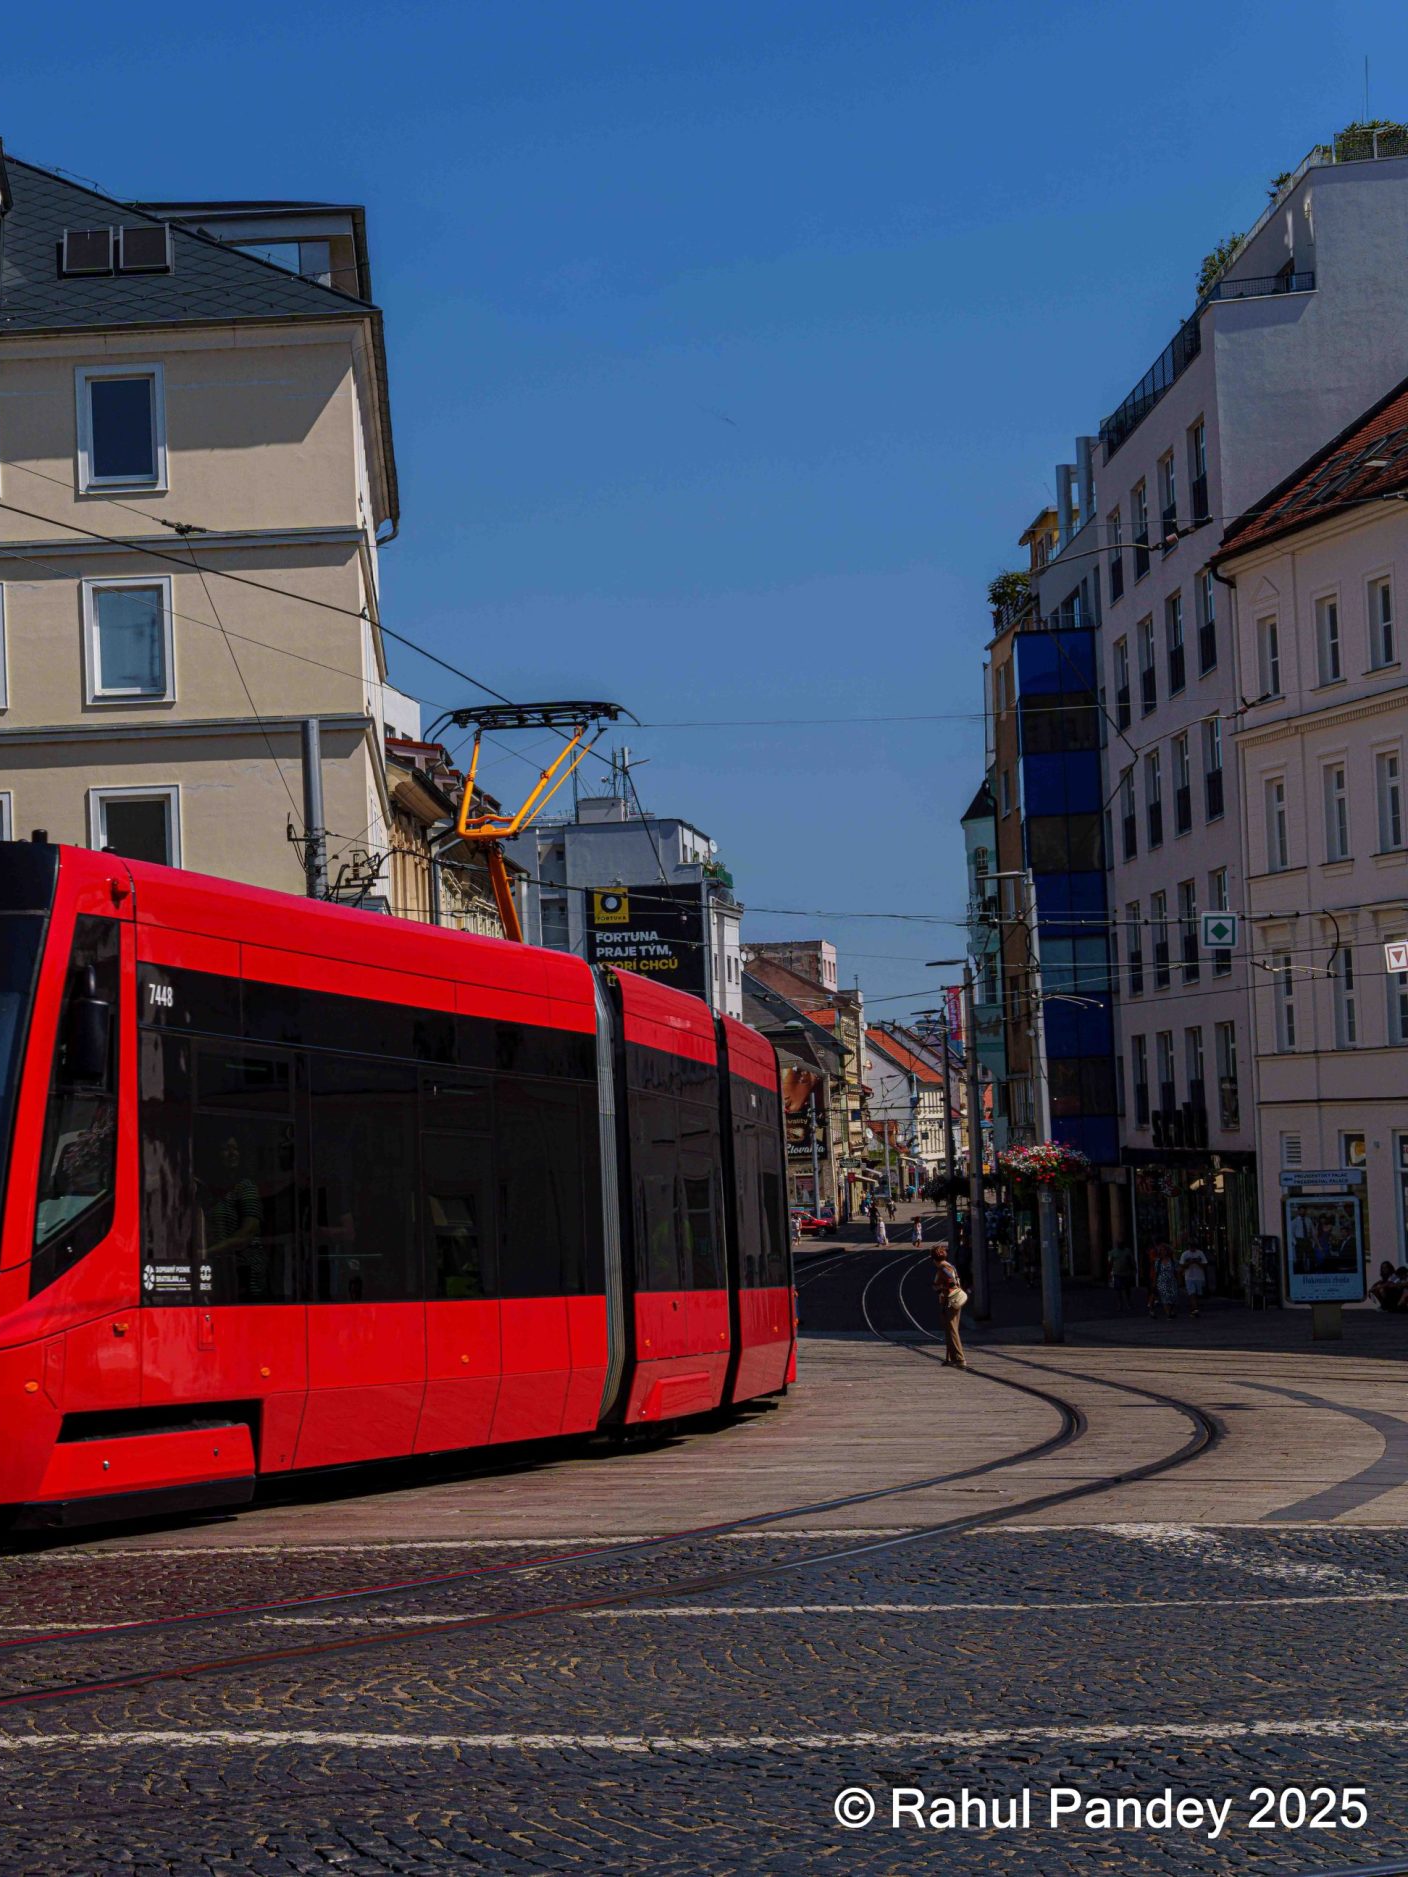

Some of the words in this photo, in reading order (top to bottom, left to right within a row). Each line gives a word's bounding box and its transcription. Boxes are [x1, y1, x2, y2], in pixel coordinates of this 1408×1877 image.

[595, 931, 659, 943] FORTUNA
[596, 946, 636, 957] PRAJE
[639, 943, 672, 957] TÝM,
[639, 957, 679, 970] CHCÚ
[149, 983, 174, 1008] 7448
